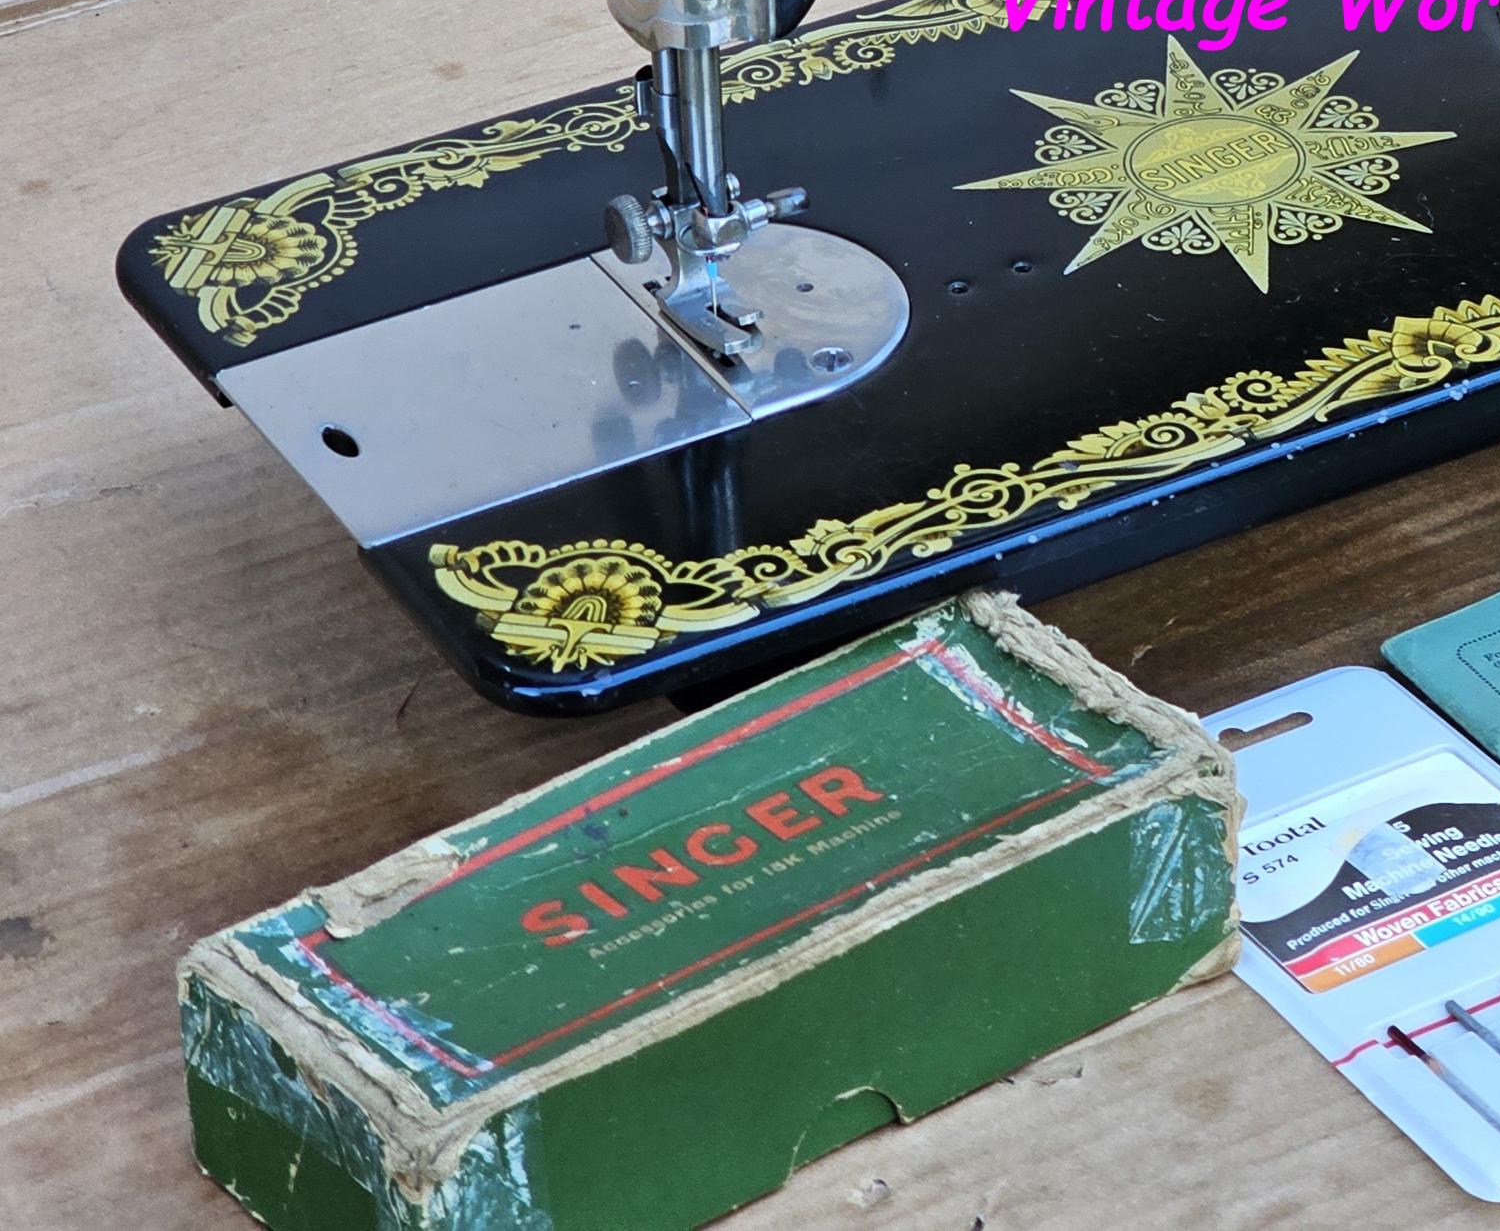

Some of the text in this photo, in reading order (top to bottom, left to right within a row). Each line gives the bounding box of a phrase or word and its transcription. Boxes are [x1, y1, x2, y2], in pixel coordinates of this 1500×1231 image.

[1137, 129, 1292, 197] SINGER
[1239, 816, 1328, 858] Tootal
[1381, 826, 1465, 861] Sewing
[1392, 820, 1412, 834] 5
[520, 764, 885, 948] SINGER
[1242, 853, 1300, 886] S 574
[588, 891, 719, 960] Accessories
[720, 874, 757, 897] for
[805, 808, 903, 857] Machine
[1341, 858, 1435, 901] Machine
[1286, 912, 1350, 952] Produced
[1350, 902, 1370, 920] for
[1437, 862, 1473, 884] other
[1453, 902, 1497, 927] 14/90
[1352, 911, 1431, 947] Woven
[1333, 952, 1377, 977] 11/80
